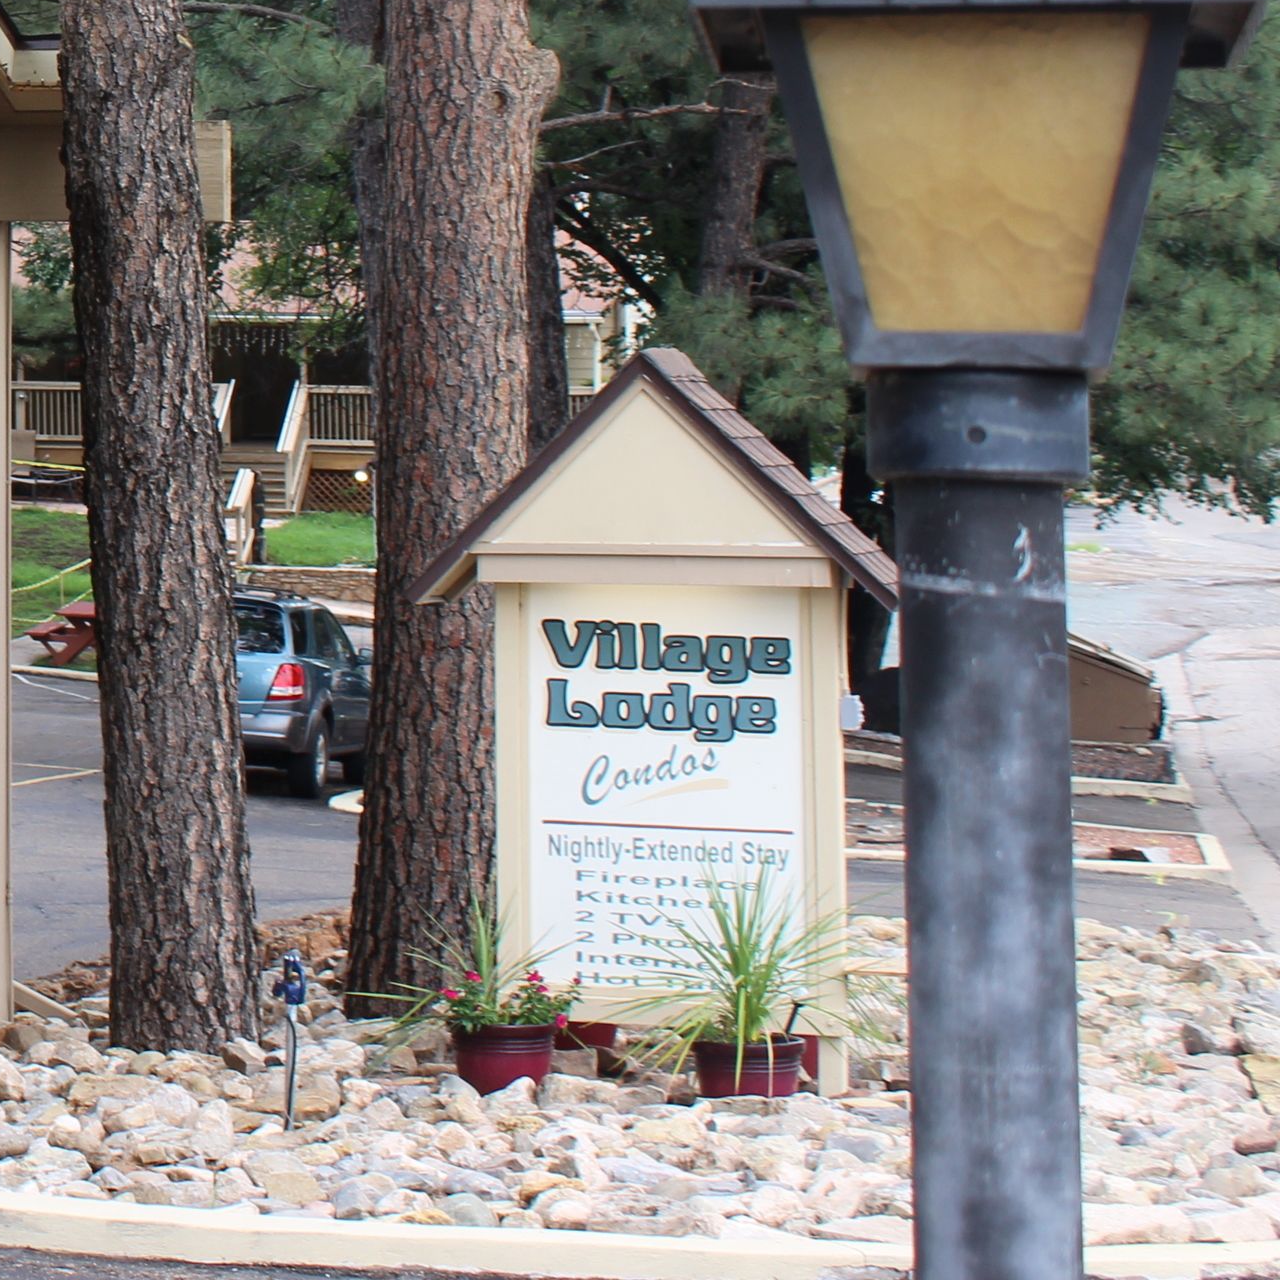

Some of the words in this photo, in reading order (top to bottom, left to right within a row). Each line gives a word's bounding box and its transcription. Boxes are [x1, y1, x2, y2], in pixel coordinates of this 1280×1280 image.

[542, 618, 792, 684] Village
[545, 678, 777, 743] Lodge
[581, 744, 720, 806] Condos
[548, 834, 733, 864] Nightly-Extended
[741, 841, 790, 871] Stay
[575, 870, 759, 892] Fireplace
[576, 890, 730, 910] Kitchen
[575, 910, 594, 923] 2
[610, 912, 686, 928] TVs
[575, 930, 594, 943] 2
[576, 951, 731, 972] Interne
